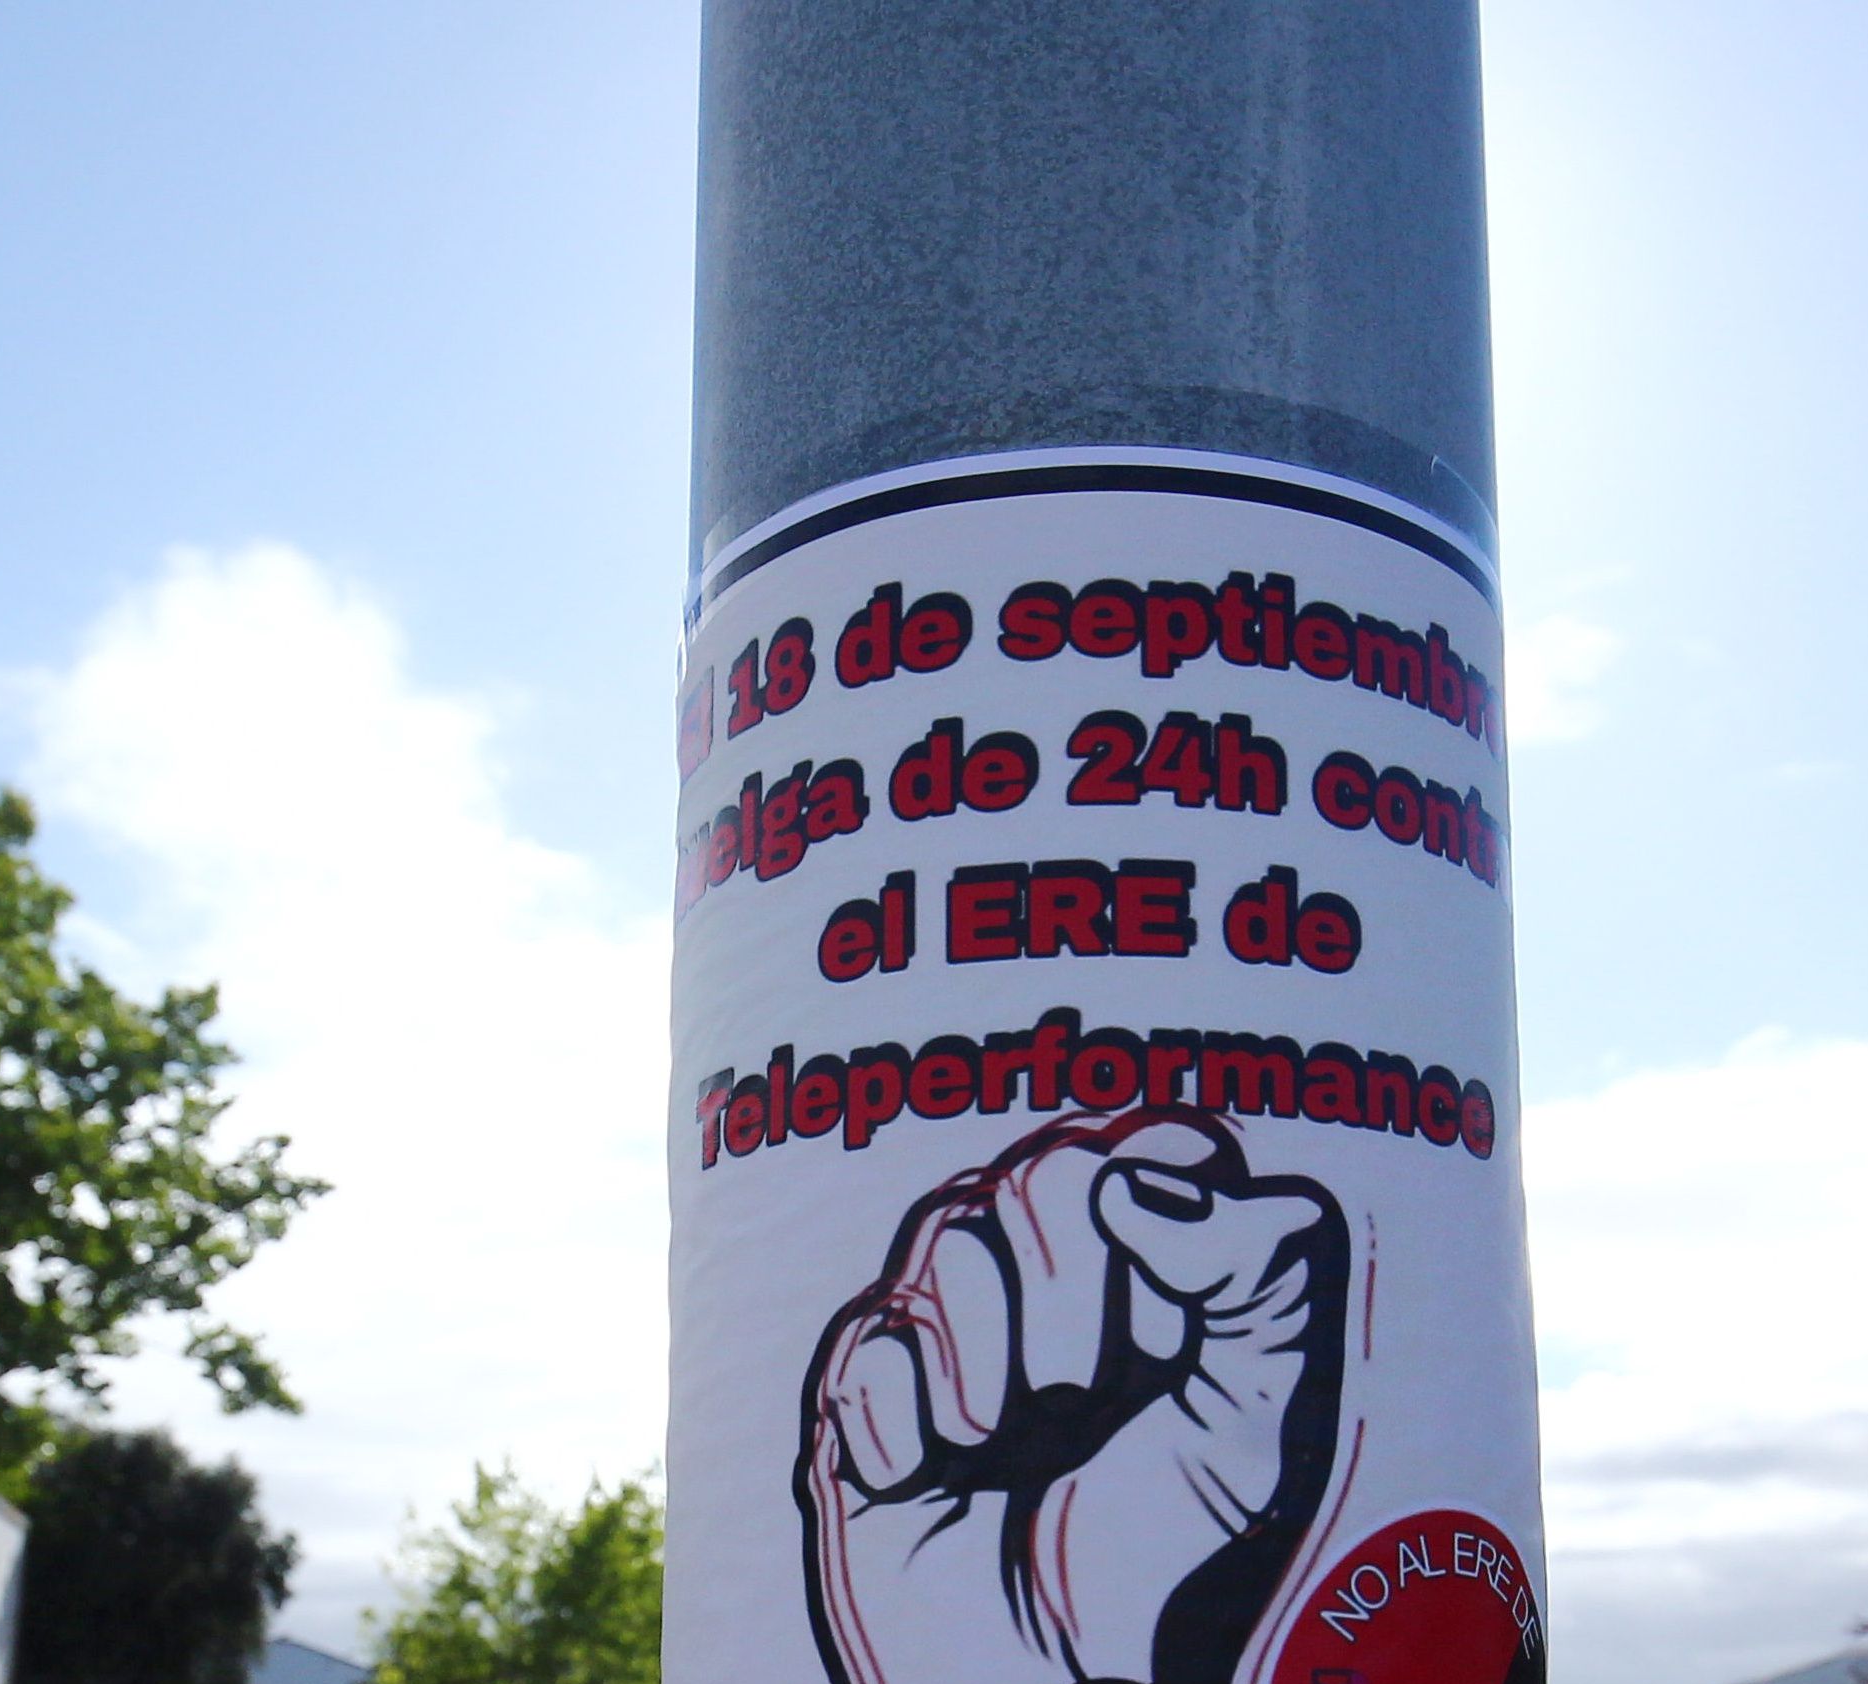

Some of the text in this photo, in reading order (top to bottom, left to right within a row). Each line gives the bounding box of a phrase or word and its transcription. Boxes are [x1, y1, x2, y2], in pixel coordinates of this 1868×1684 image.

[727, 616, 816, 740] 18
[835, 582, 974, 688] de
[889, 716, 1040, 821] de
[1066, 711, 1287, 815] 24h
[818, 860, 1362, 982] el ERE de
[696, 1006, 1497, 1170] Teleperformance
[1320, 1530, 1542, 1661] NO AL ERE DE
